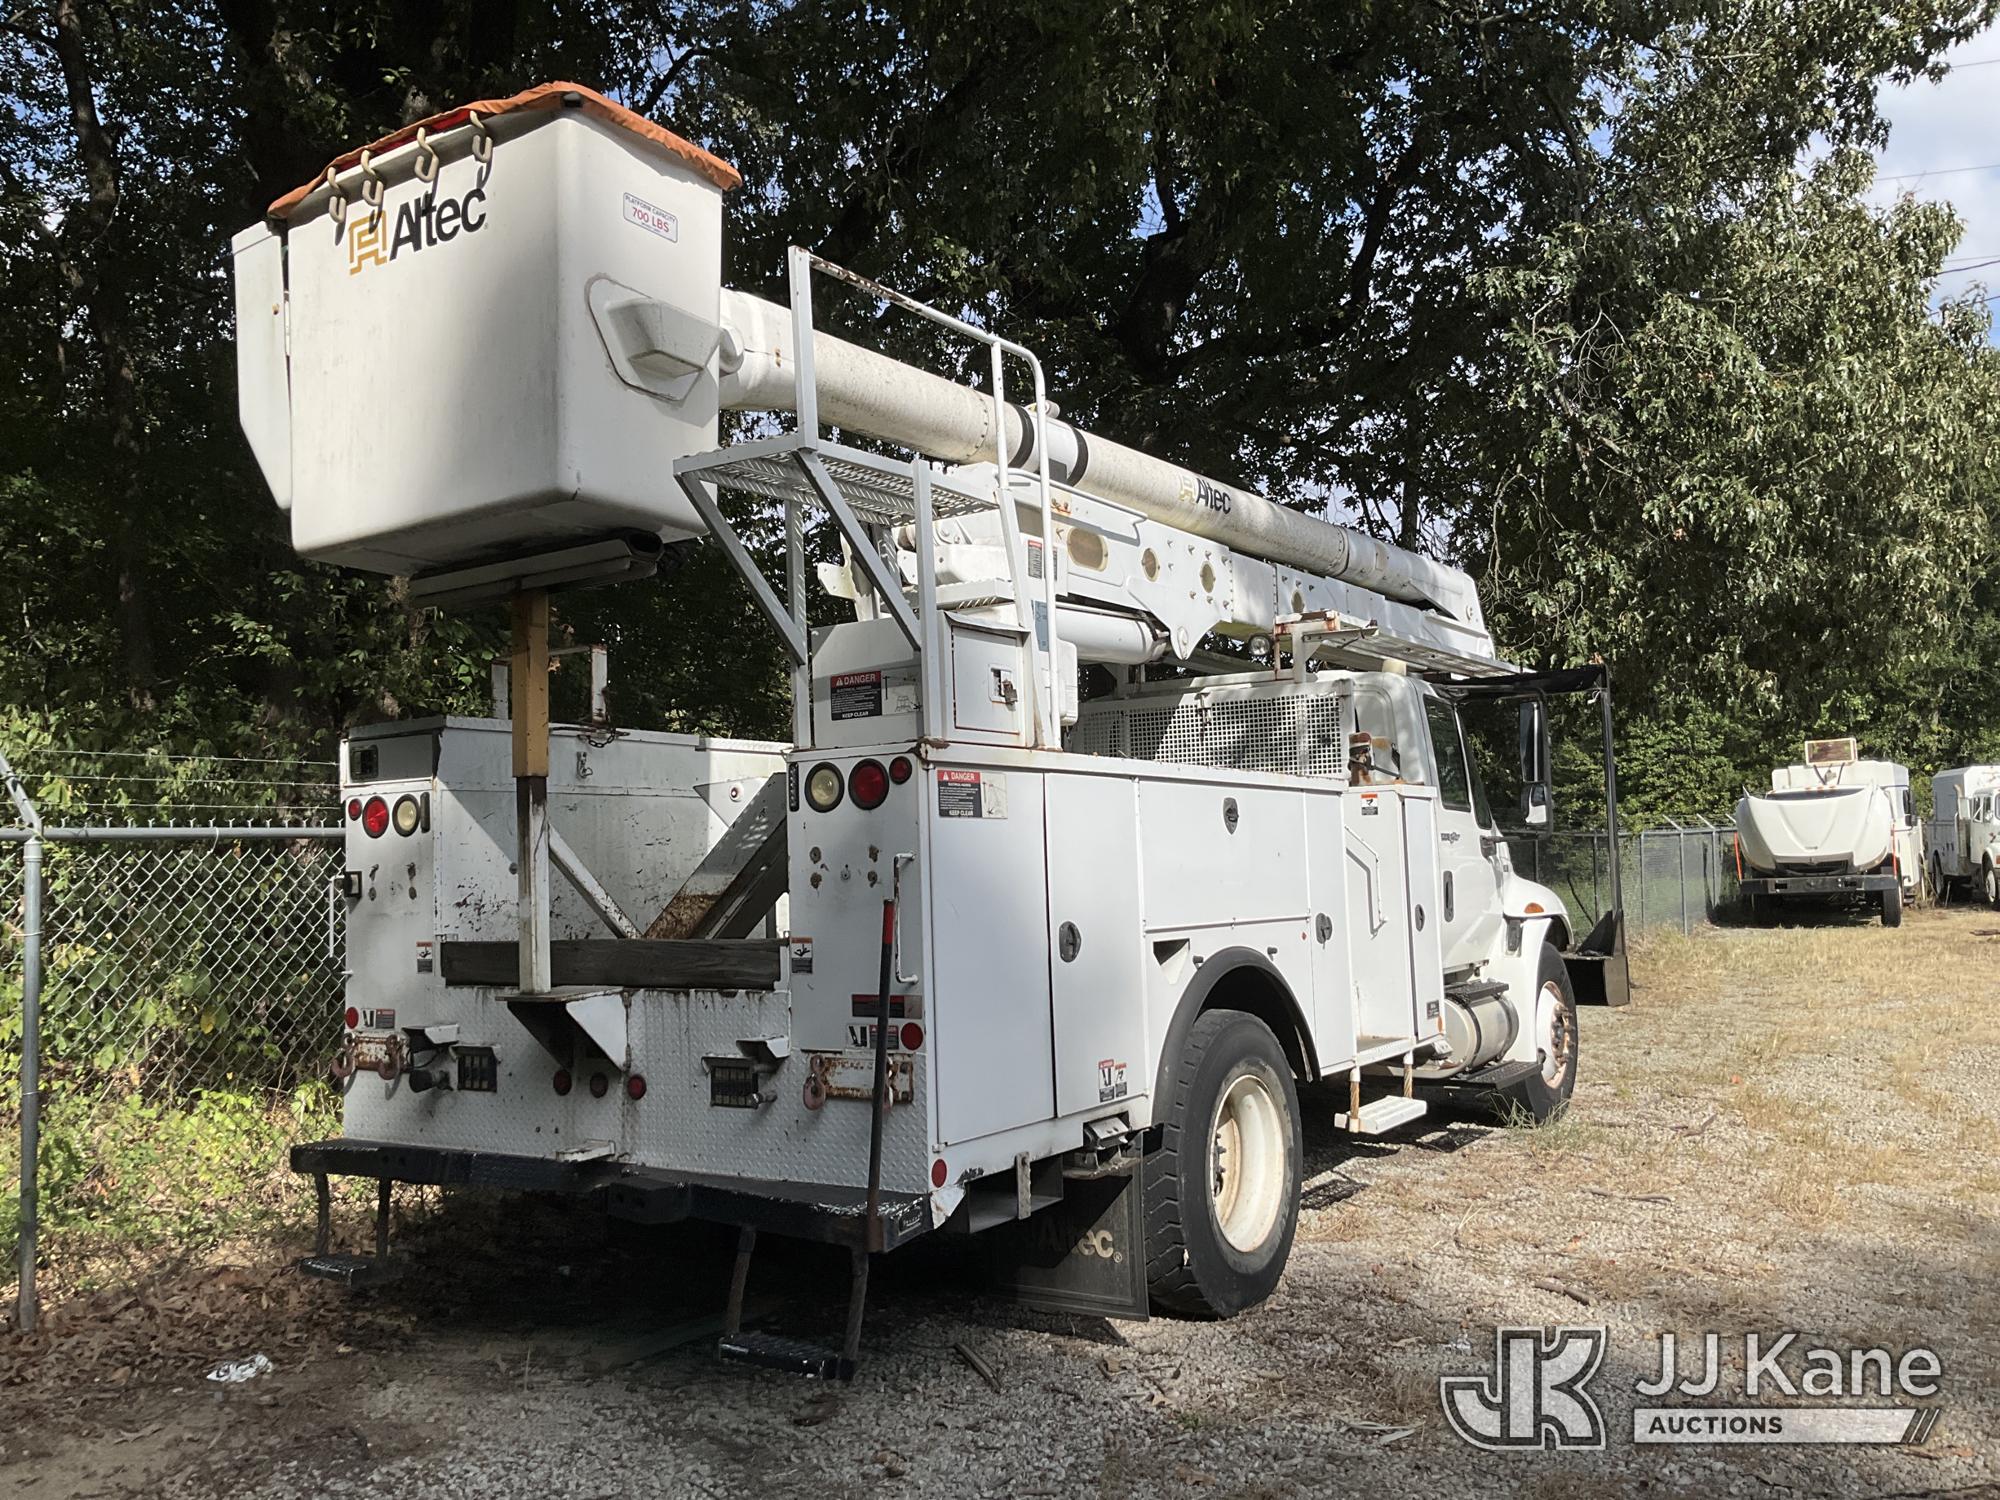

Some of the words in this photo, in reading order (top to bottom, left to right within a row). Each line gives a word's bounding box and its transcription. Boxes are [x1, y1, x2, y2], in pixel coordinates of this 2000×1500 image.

[389, 187, 487, 262] Altec
[632, 206, 650, 223] 700
[651, 215, 670, 233] LBS
[1196, 478, 1231, 514] Altec
[843, 673, 876, 686] DANGER
[950, 771, 975, 781] DANGER
